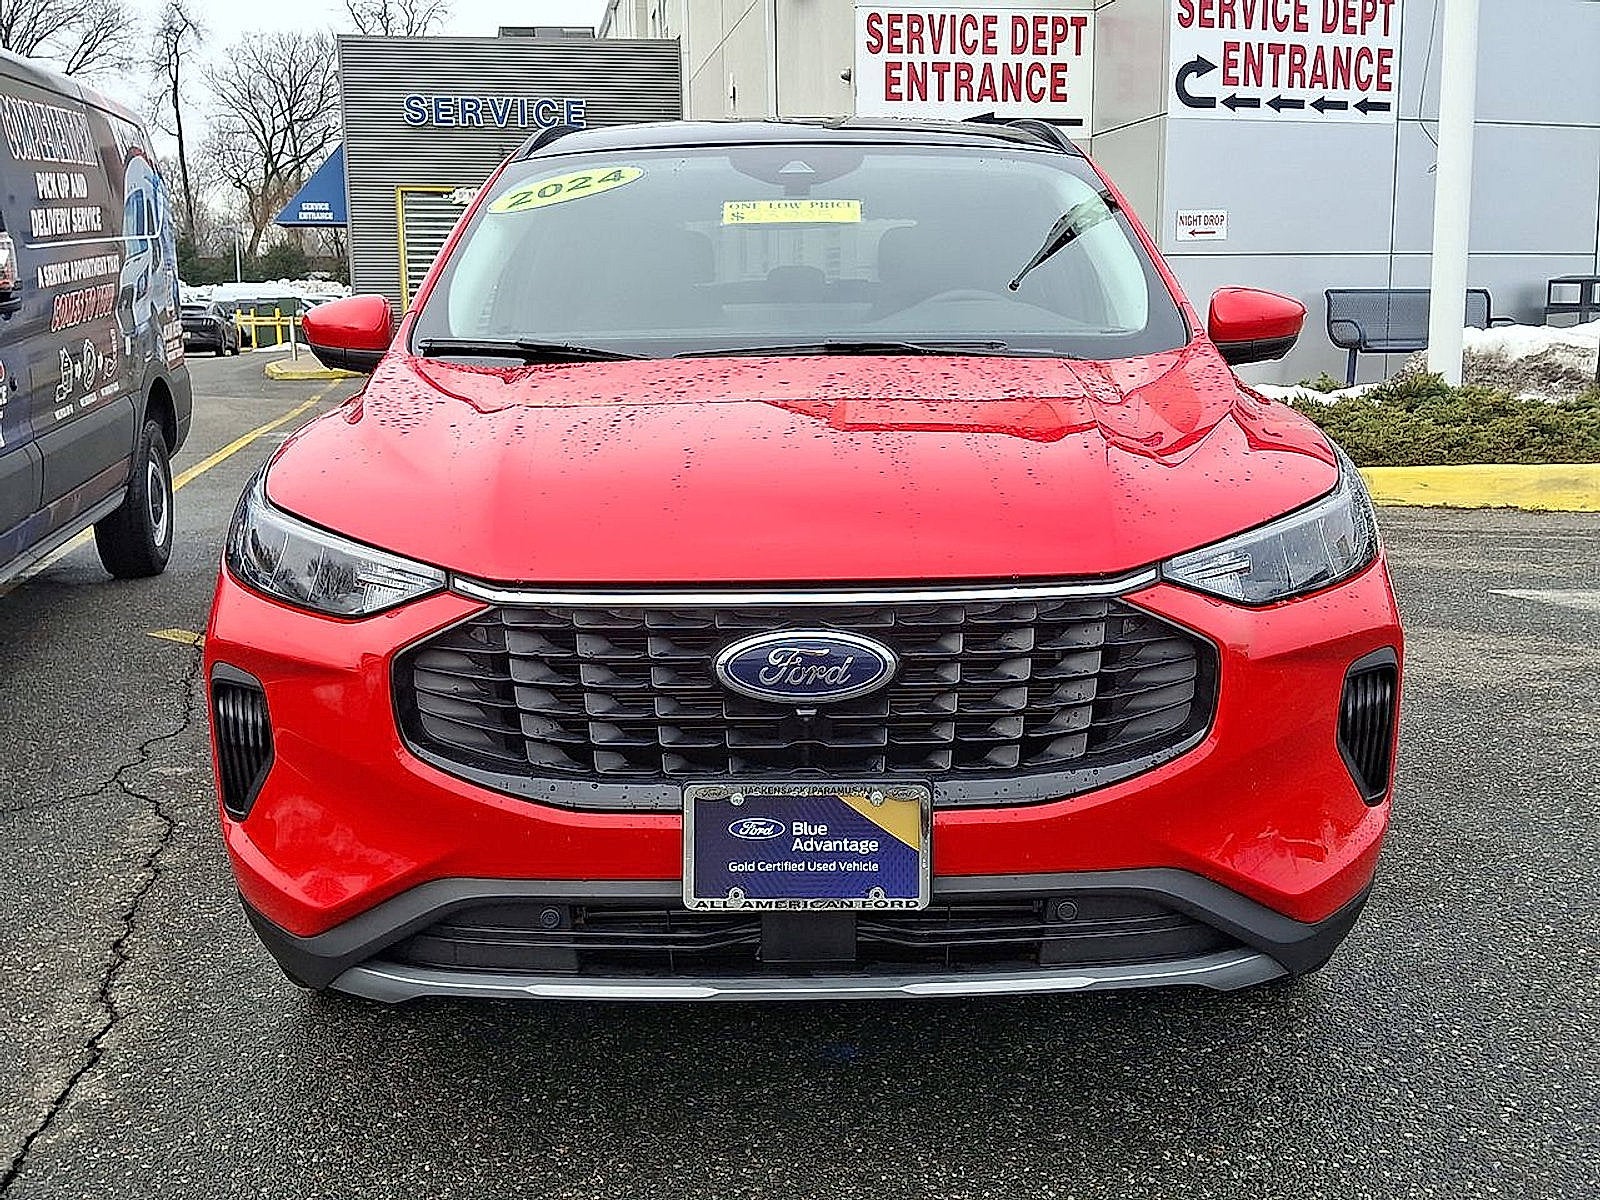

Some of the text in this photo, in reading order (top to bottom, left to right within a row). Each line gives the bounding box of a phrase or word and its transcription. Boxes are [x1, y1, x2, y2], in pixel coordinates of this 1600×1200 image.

[1177, 0, 1396, 37] SERVICE DEPT
[866, 12, 1088, 56] SERVICE DEPT
[1222, 41, 1393, 92] ENTRANCE
[884, 61, 1068, 103] ENTRANCE
[403, 93, 587, 129] SERVICE
[35, 172, 88, 200] PICK UP AND
[507, 169, 625, 209] 2024
[729, 201, 857, 210] ONE LOW PRICE
[1179, 215, 1225, 226] NIGHT DROP
[30, 206, 103, 238] DELIVERY SERVICE
[758, 647, 854, 686] Ford
[738, 821, 774, 836] Ford
[791, 821, 828, 836] Blue
[791, 837, 879, 854] Advantage
[728, 861, 879, 872] Gold Certified Used Vehicle
[695, 900, 919, 910] ALL AMERICAN FORD
